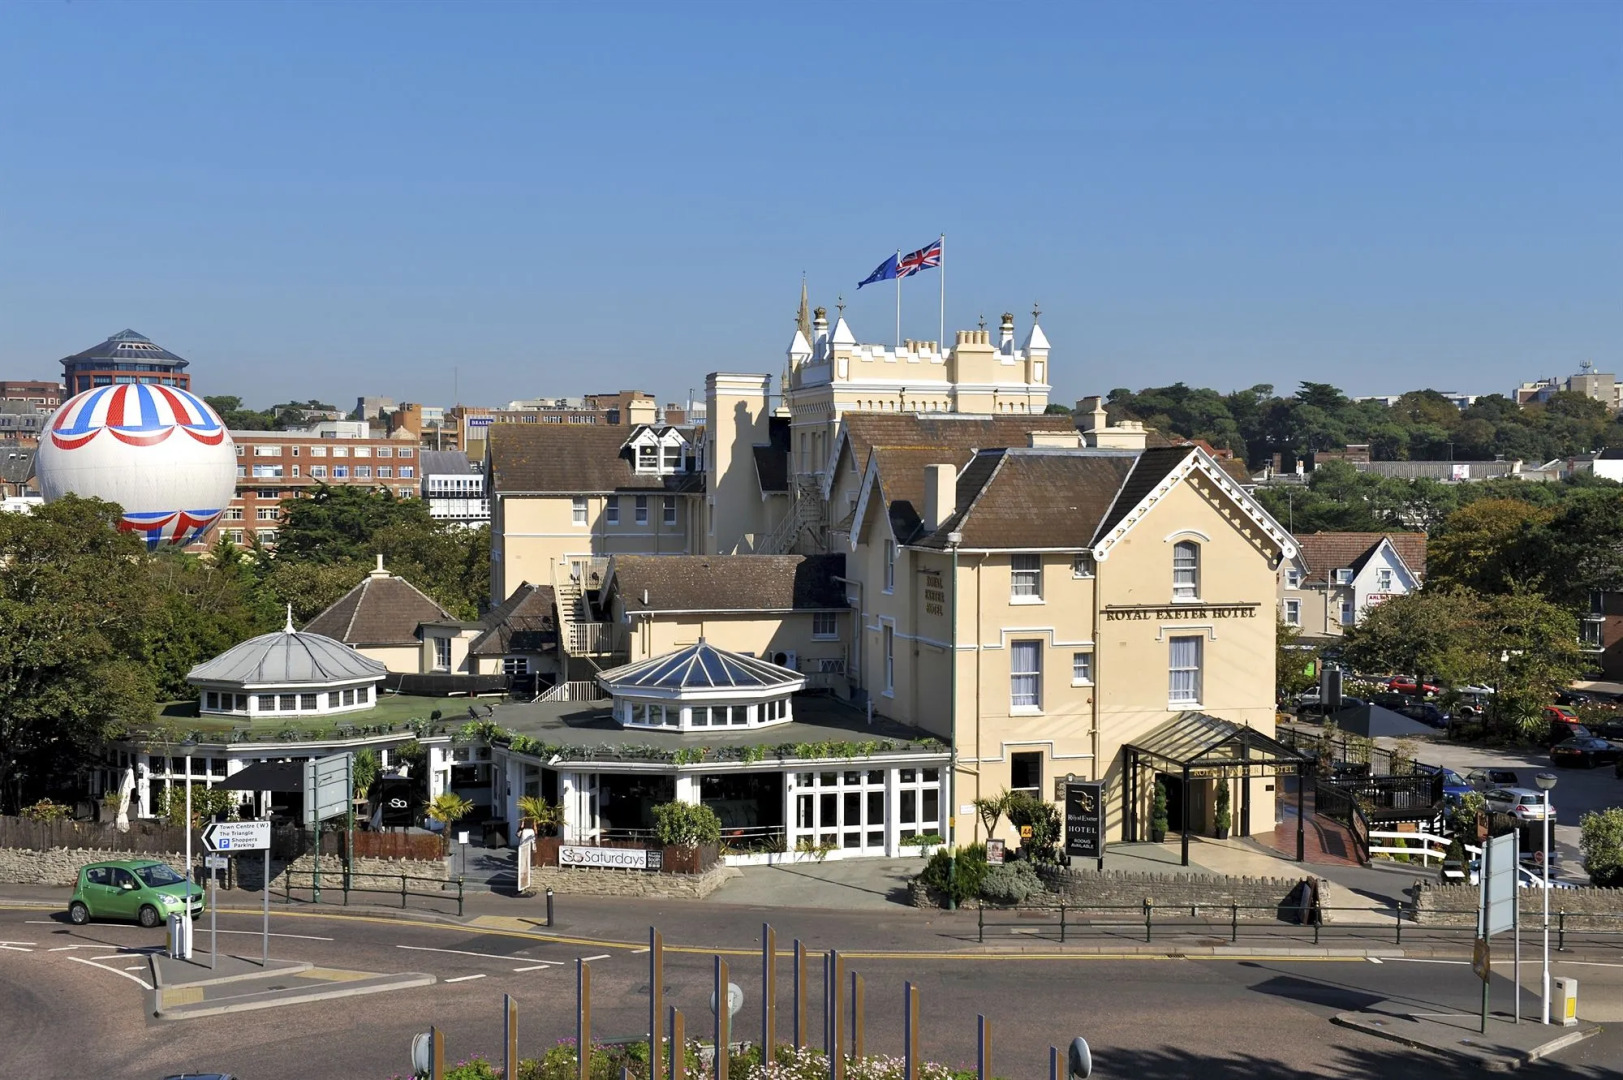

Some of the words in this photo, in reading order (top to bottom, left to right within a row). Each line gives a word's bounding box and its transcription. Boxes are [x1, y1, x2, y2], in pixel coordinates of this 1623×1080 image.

[1106, 610, 1150, 621] ROYAL
[1156, 608, 1207, 620] EXETER
[1212, 607, 1256, 618] HOTEL
[1194, 768, 1219, 776] ROYAL
[1267, 765, 1294, 773] HOTEL
[1068, 826, 1097, 834] HOTEL
[584, 850, 645, 866] Saturdays
